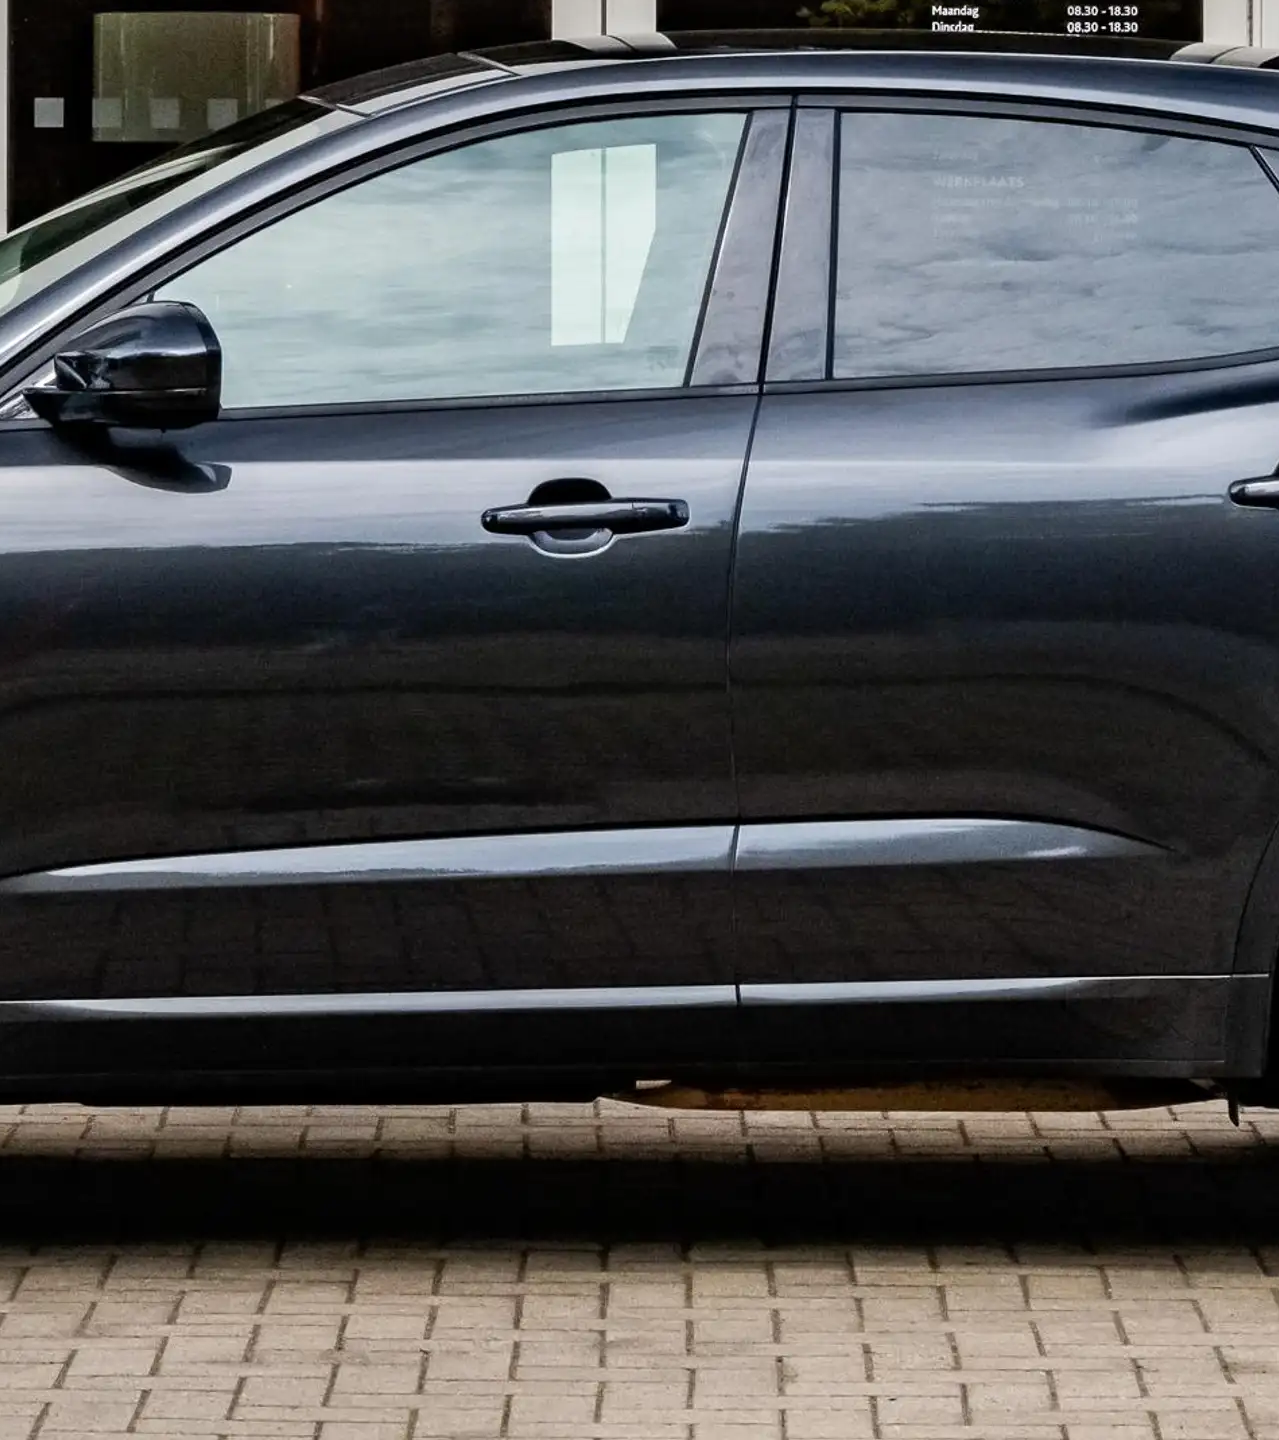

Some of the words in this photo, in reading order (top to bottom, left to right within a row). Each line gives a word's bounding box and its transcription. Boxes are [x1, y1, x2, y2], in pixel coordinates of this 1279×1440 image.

[931, 5, 979, 18] Maandag
[1067, 6, 1098, 16] 08.30
[1108, 6, 1138, 16] 18.30
[1067, 22, 1098, 33] 08.30
[1108, 22, 1138, 33] 18.30
